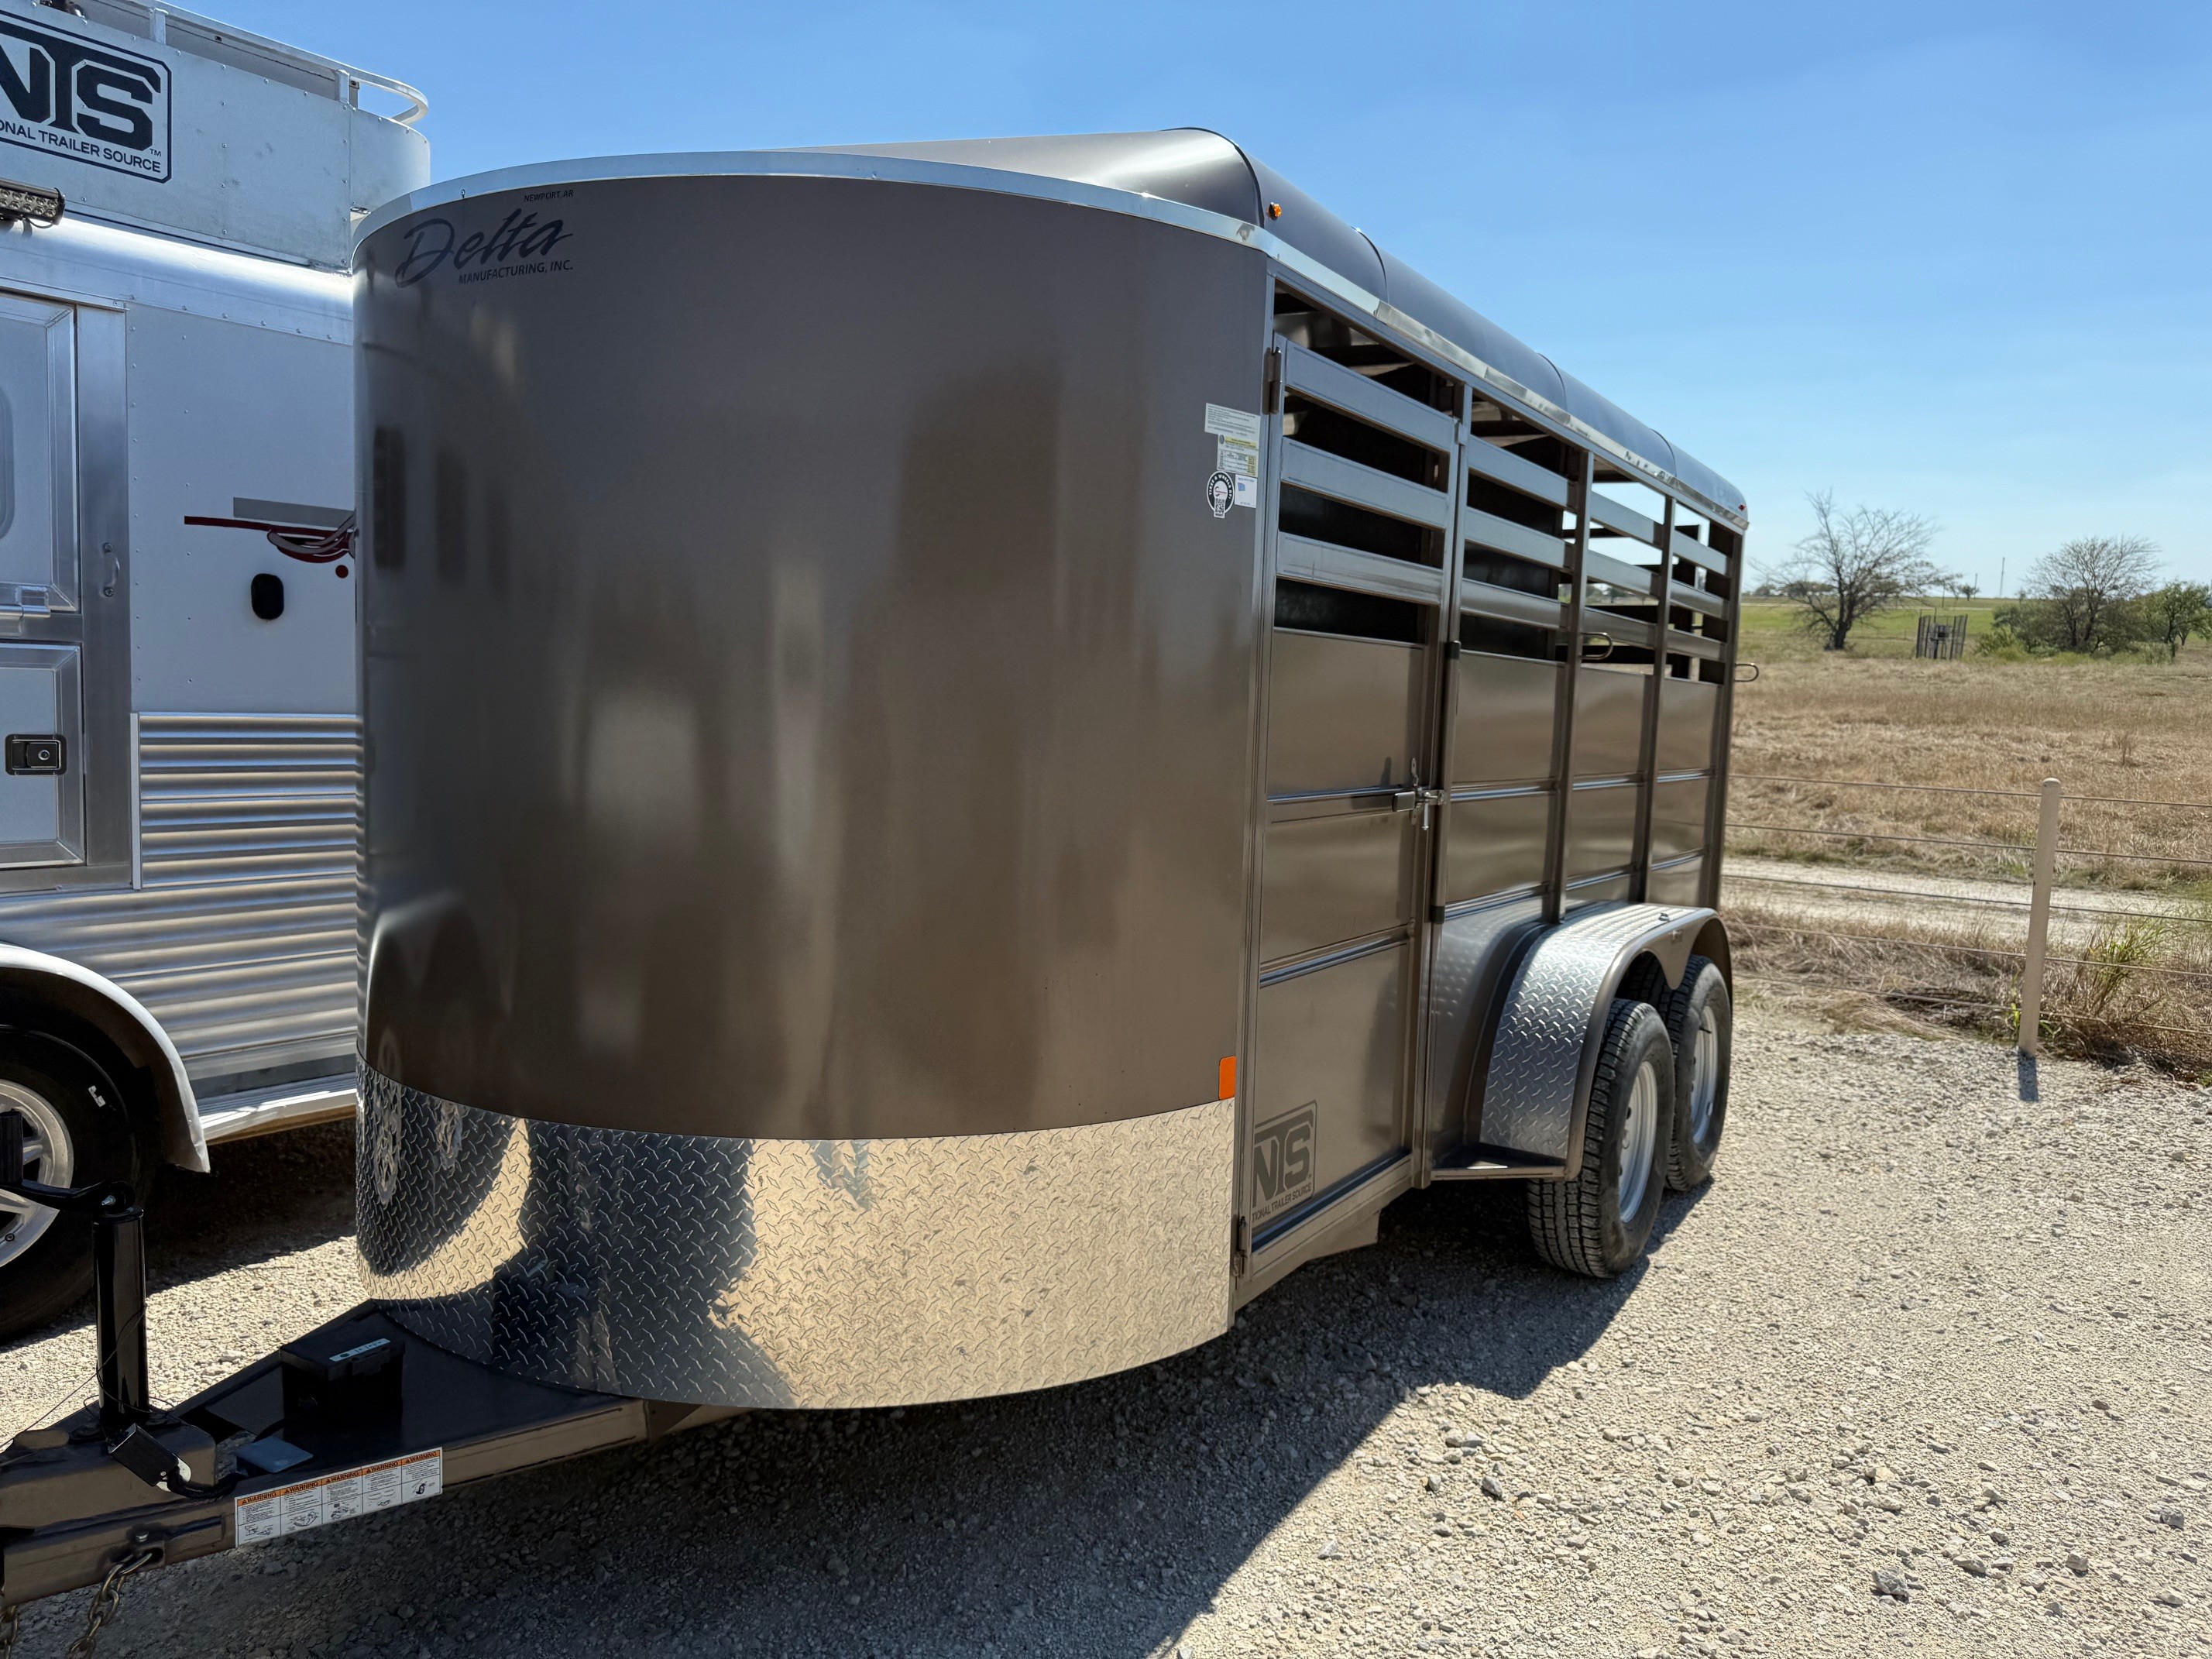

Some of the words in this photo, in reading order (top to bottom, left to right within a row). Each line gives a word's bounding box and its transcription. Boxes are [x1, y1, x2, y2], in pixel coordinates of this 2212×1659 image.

[0, 20, 161, 151] NTS
[39, 129, 100, 157] TRAILER
[103, 147, 161, 173] SOURCE
[394, 208, 573, 288] Delta
[459, 262, 548, 284] MANUFACTURING,
[550, 259, 573, 272] INC.
[1252, 1109, 1314, 1208] NTS
[1271, 1193, 1292, 1211] TRAILER
[1292, 1182, 1313, 1200] SOURCE
[331, 1471, 359, 1482] WARNING
[371, 1462, 399, 1472] WARNING
[247, 1492, 277, 1503] WARNING
[288, 1481, 318, 1492] WARNING
